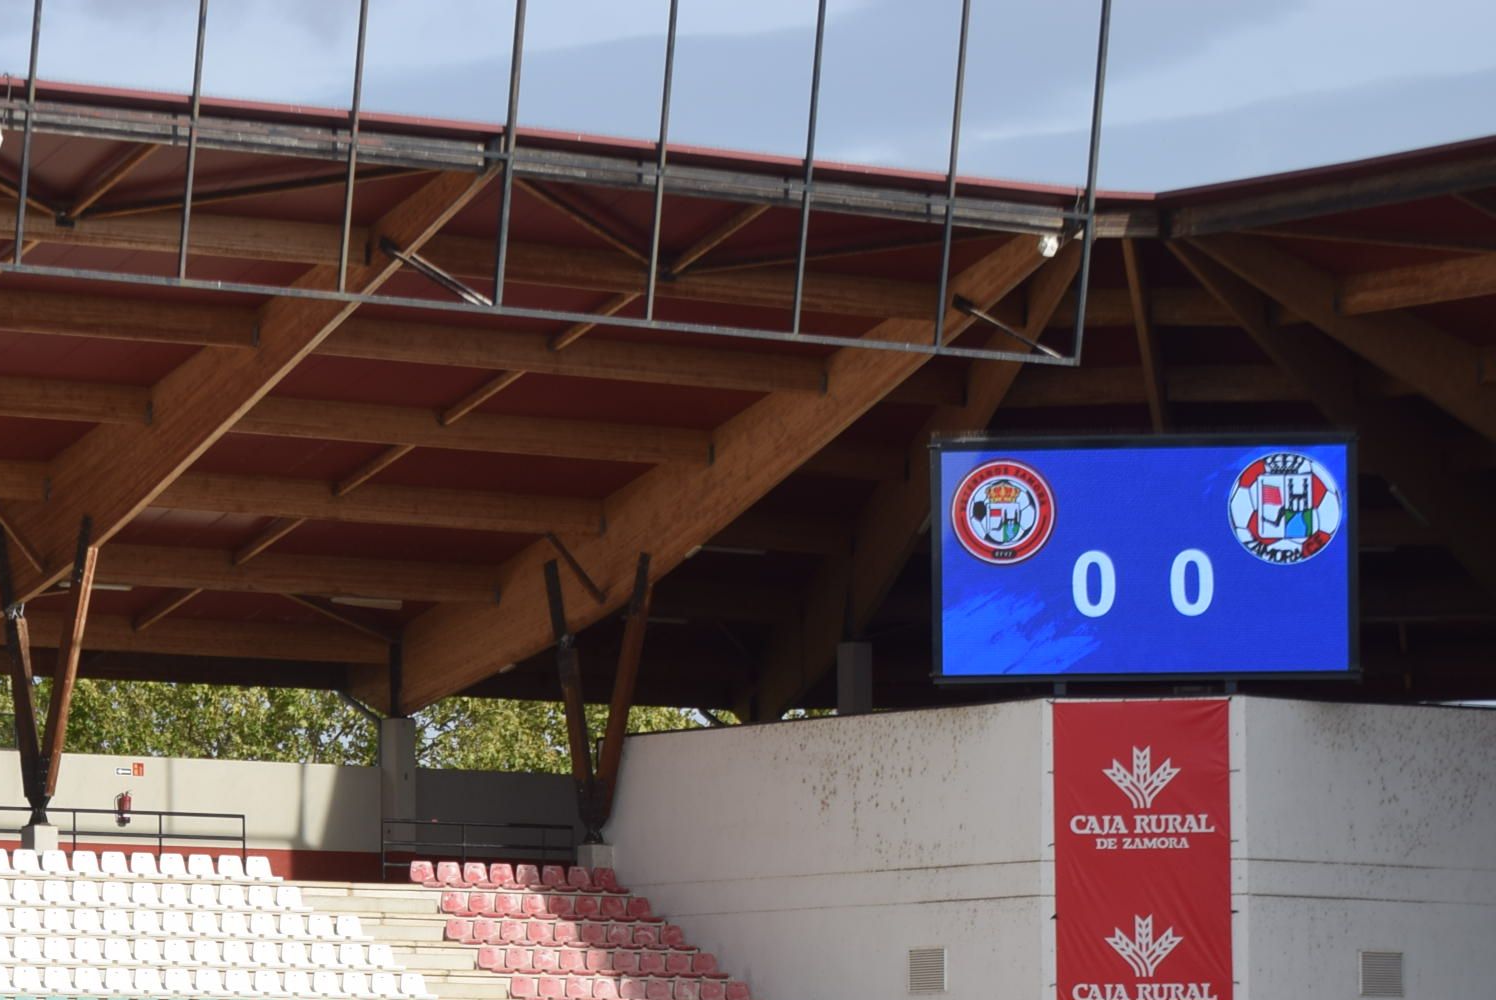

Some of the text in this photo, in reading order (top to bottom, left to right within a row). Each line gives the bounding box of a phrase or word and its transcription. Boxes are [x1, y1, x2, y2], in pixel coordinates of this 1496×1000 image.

[1072, 548, 1215, 618] 0 0
[1069, 813, 1215, 835] CAJA RURAL
[1096, 837, 1190, 850] DE ZAMORA
